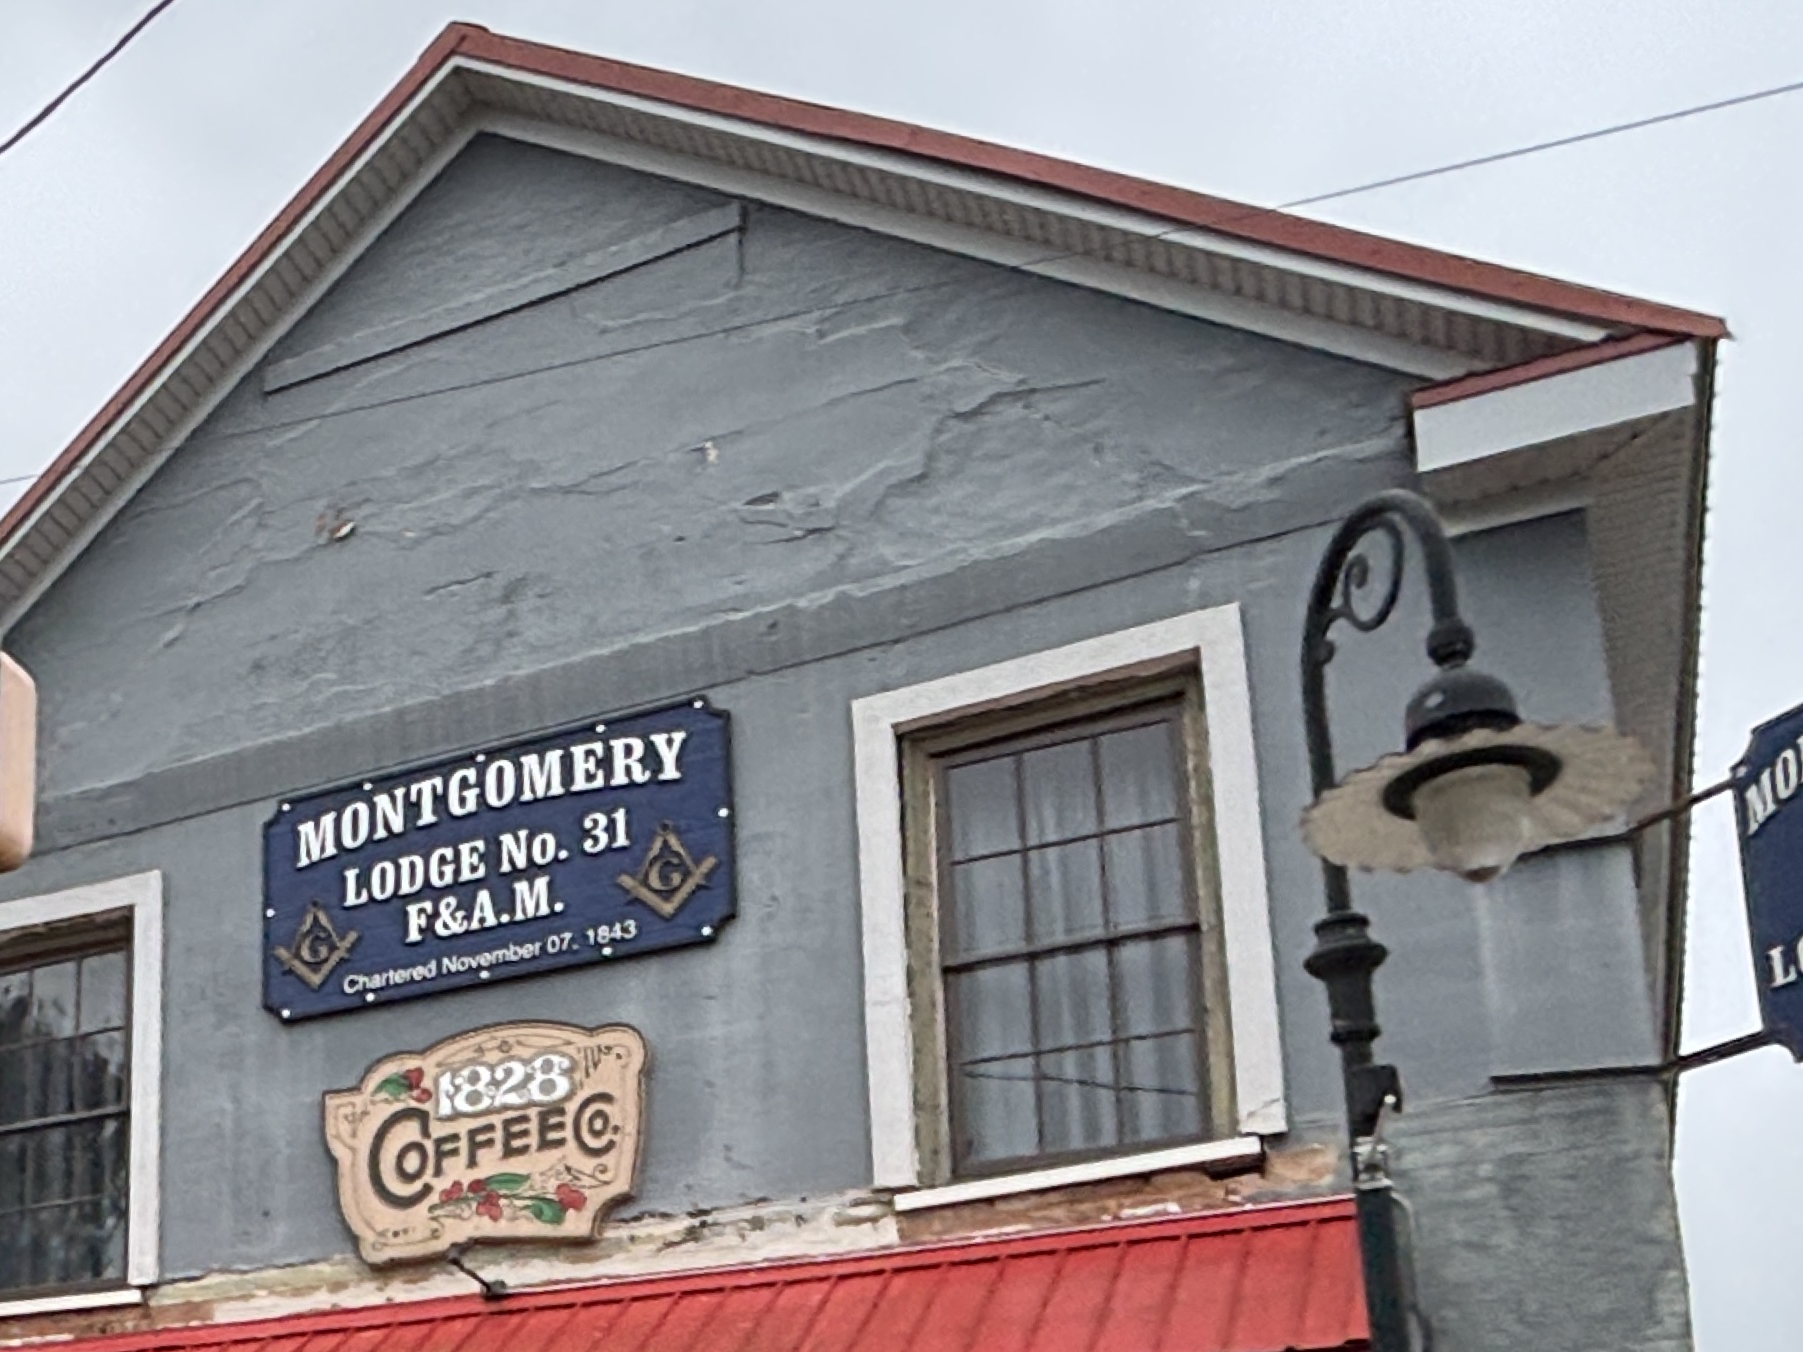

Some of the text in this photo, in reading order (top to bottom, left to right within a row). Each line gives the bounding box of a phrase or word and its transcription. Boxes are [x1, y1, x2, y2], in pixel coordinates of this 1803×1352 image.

[296, 730, 687, 870] MONTGOMERY
[342, 808, 632, 909] LODGE No. 31
[404, 875, 565, 945] F&A.M.
[343, 961, 438, 994] Chartered
[442, 940, 543, 976] November
[586, 919, 638, 946] 1843
[436, 1053, 572, 1117] 1828
[369, 1106, 568, 1209] COFFEE
